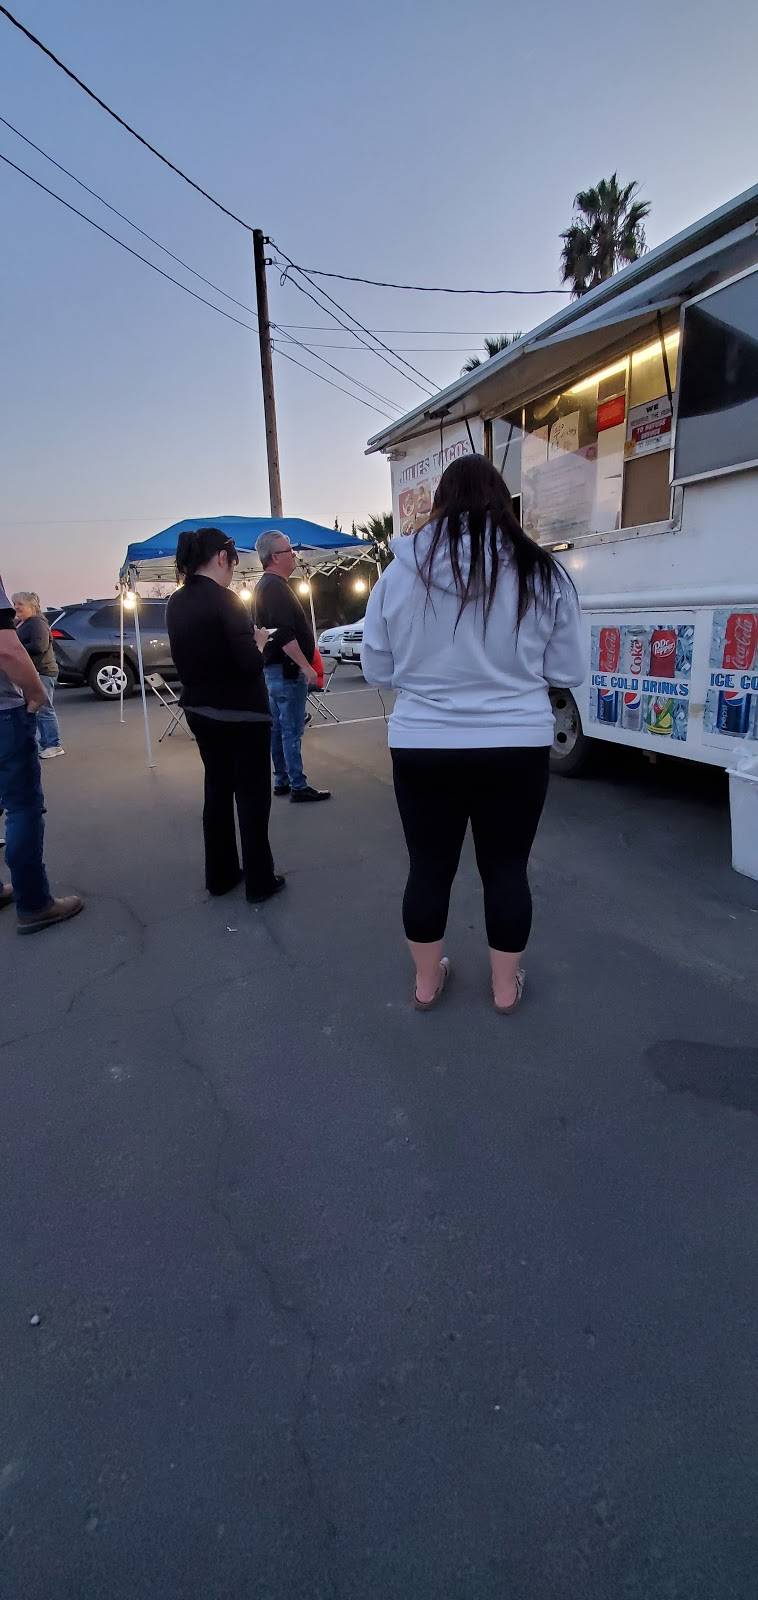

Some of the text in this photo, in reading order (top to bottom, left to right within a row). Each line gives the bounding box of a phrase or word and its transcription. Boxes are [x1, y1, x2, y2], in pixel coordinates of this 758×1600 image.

[646, 403, 659, 413] WE
[630, 640, 642, 675] Coke
[592, 674, 689, 697] ICE COLD DRINKS
[710, 672, 735, 689] ICE
